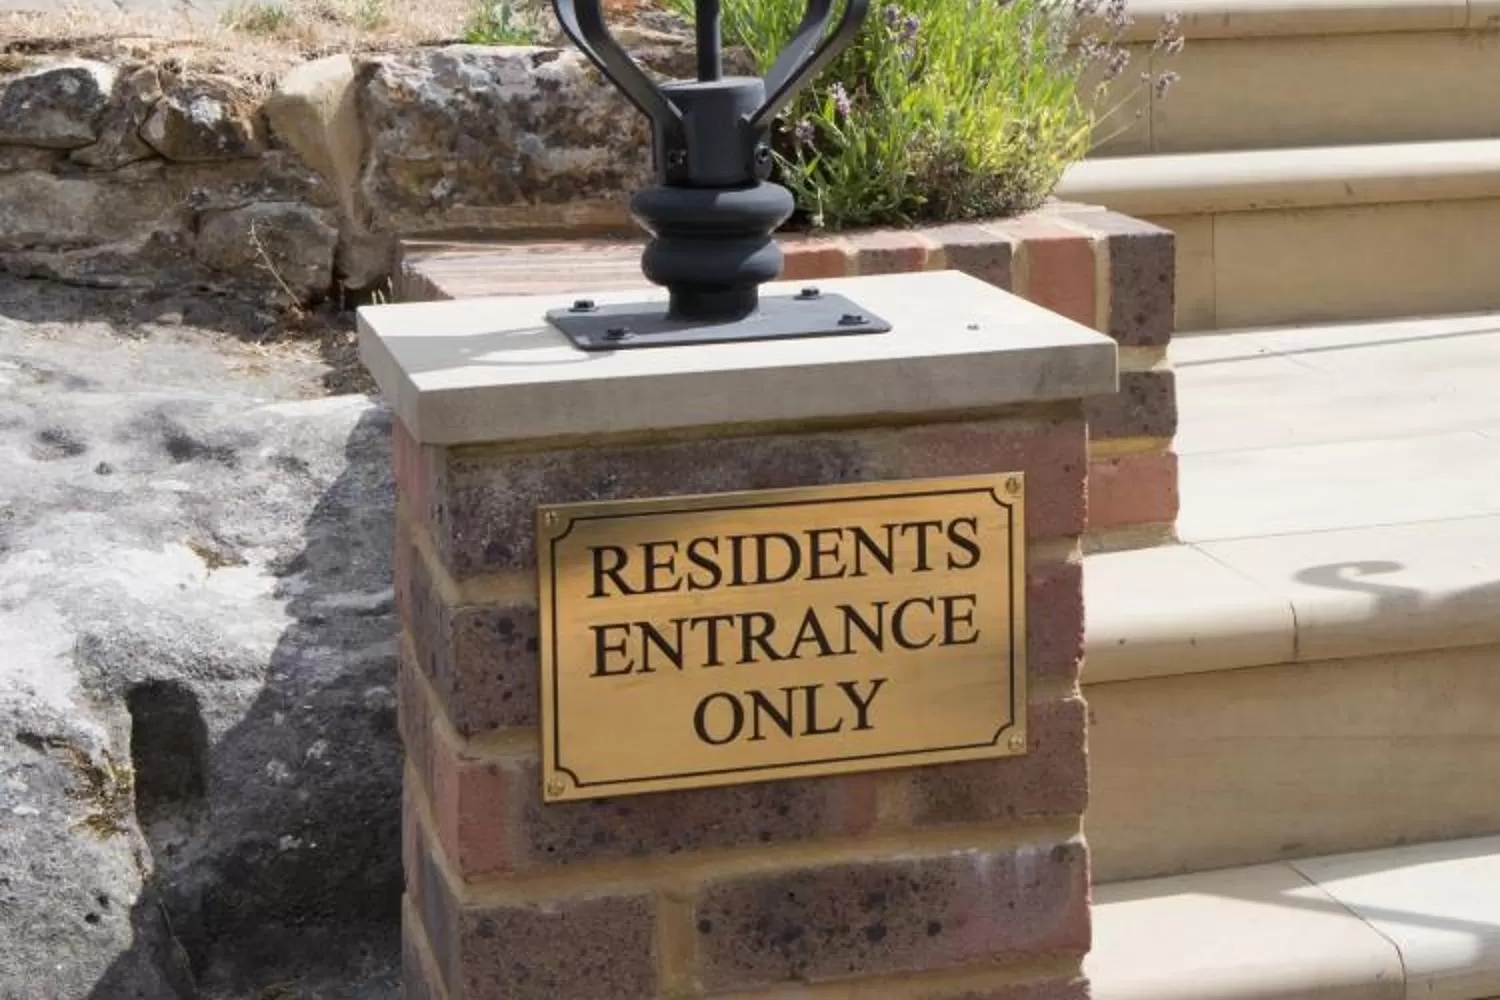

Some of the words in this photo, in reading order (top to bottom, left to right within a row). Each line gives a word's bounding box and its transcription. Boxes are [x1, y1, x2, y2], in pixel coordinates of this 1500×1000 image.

[587, 516, 981, 598] RESIDENTS
[588, 594, 981, 677] ENTRANCE
[693, 678, 888, 745] ONLY
